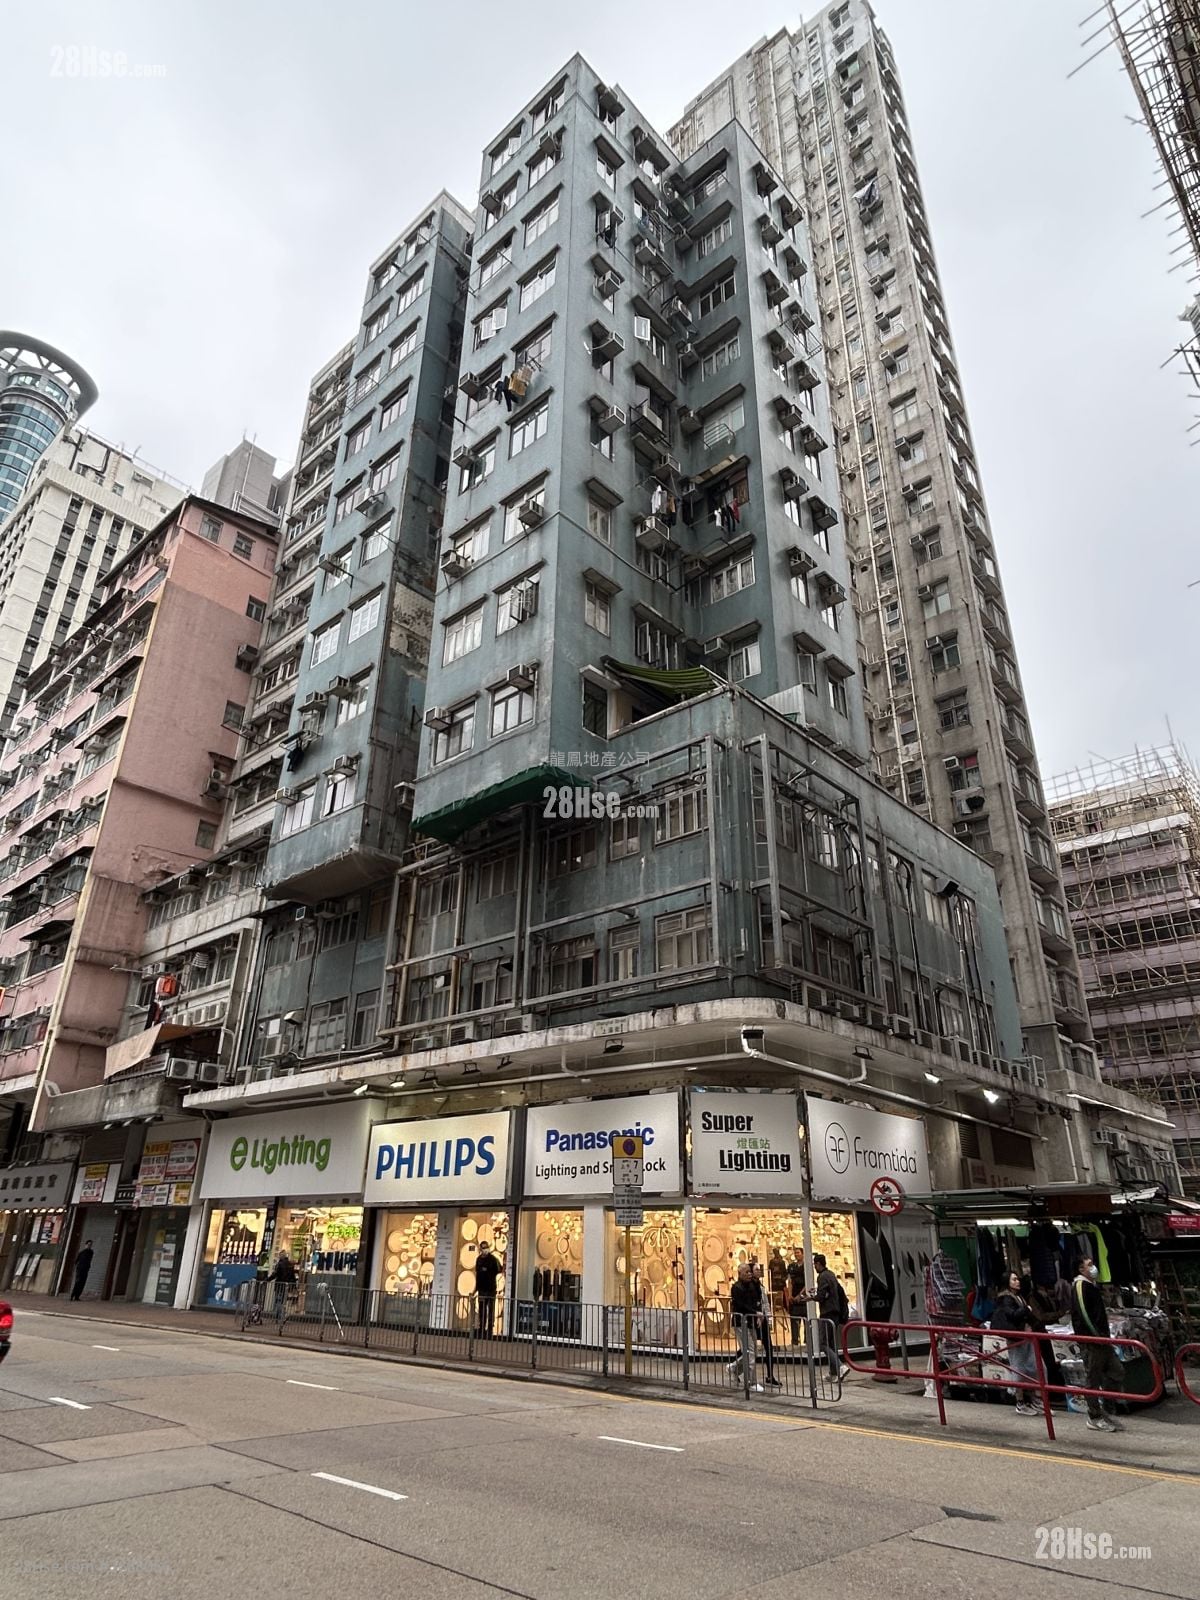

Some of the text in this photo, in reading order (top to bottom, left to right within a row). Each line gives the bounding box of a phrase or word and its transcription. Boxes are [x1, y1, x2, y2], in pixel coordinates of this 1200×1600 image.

[701, 1111, 755, 1133] Super
[736, 1137, 771, 1150] 燈匯站
[374, 1135, 496, 1181] PHILIPS
[535, 1162, 577, 1180] Lighting
[579, 1161, 600, 1175] and
[643, 1157, 666, 1172] ock
[719, 1149, 791, 1173] Lighting
